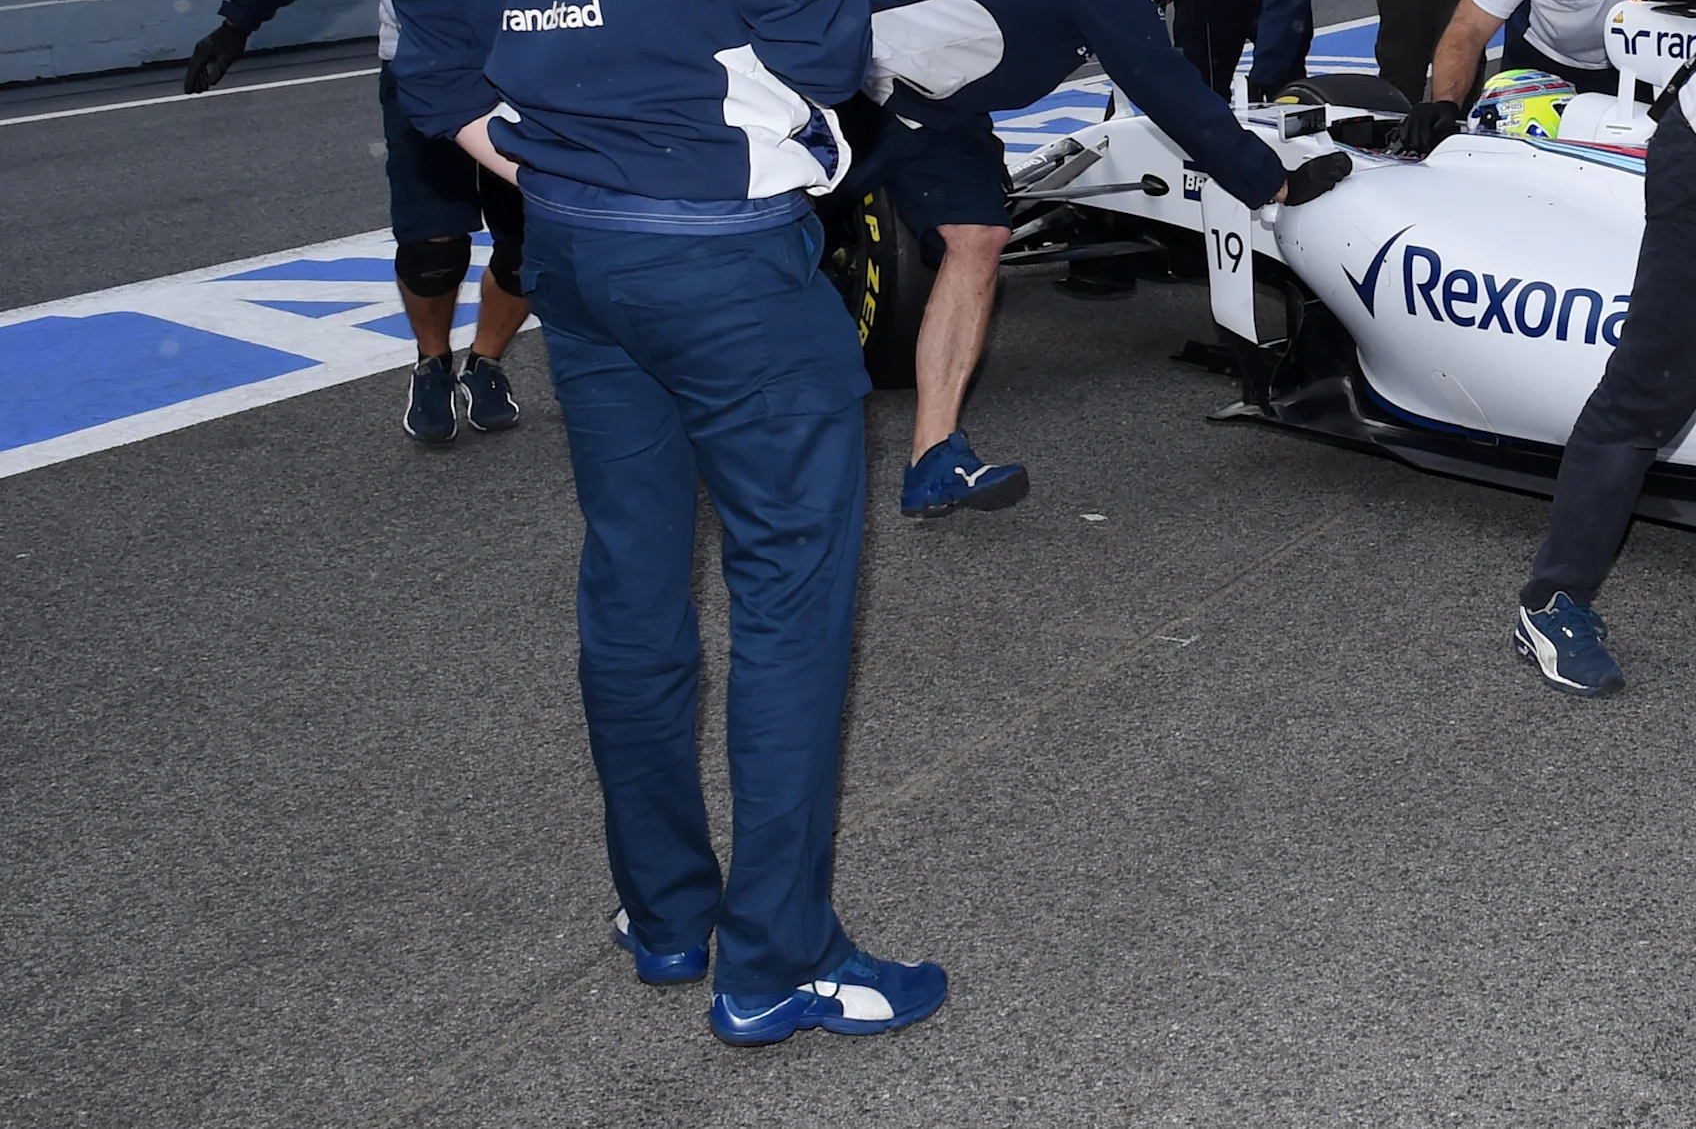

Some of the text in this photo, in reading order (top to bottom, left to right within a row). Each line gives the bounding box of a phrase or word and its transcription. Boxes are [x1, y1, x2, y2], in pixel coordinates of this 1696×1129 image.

[858, 214, 880, 347] P ZER
[1211, 228, 1244, 274] 19
[1402, 244, 1633, 347] Rexona
